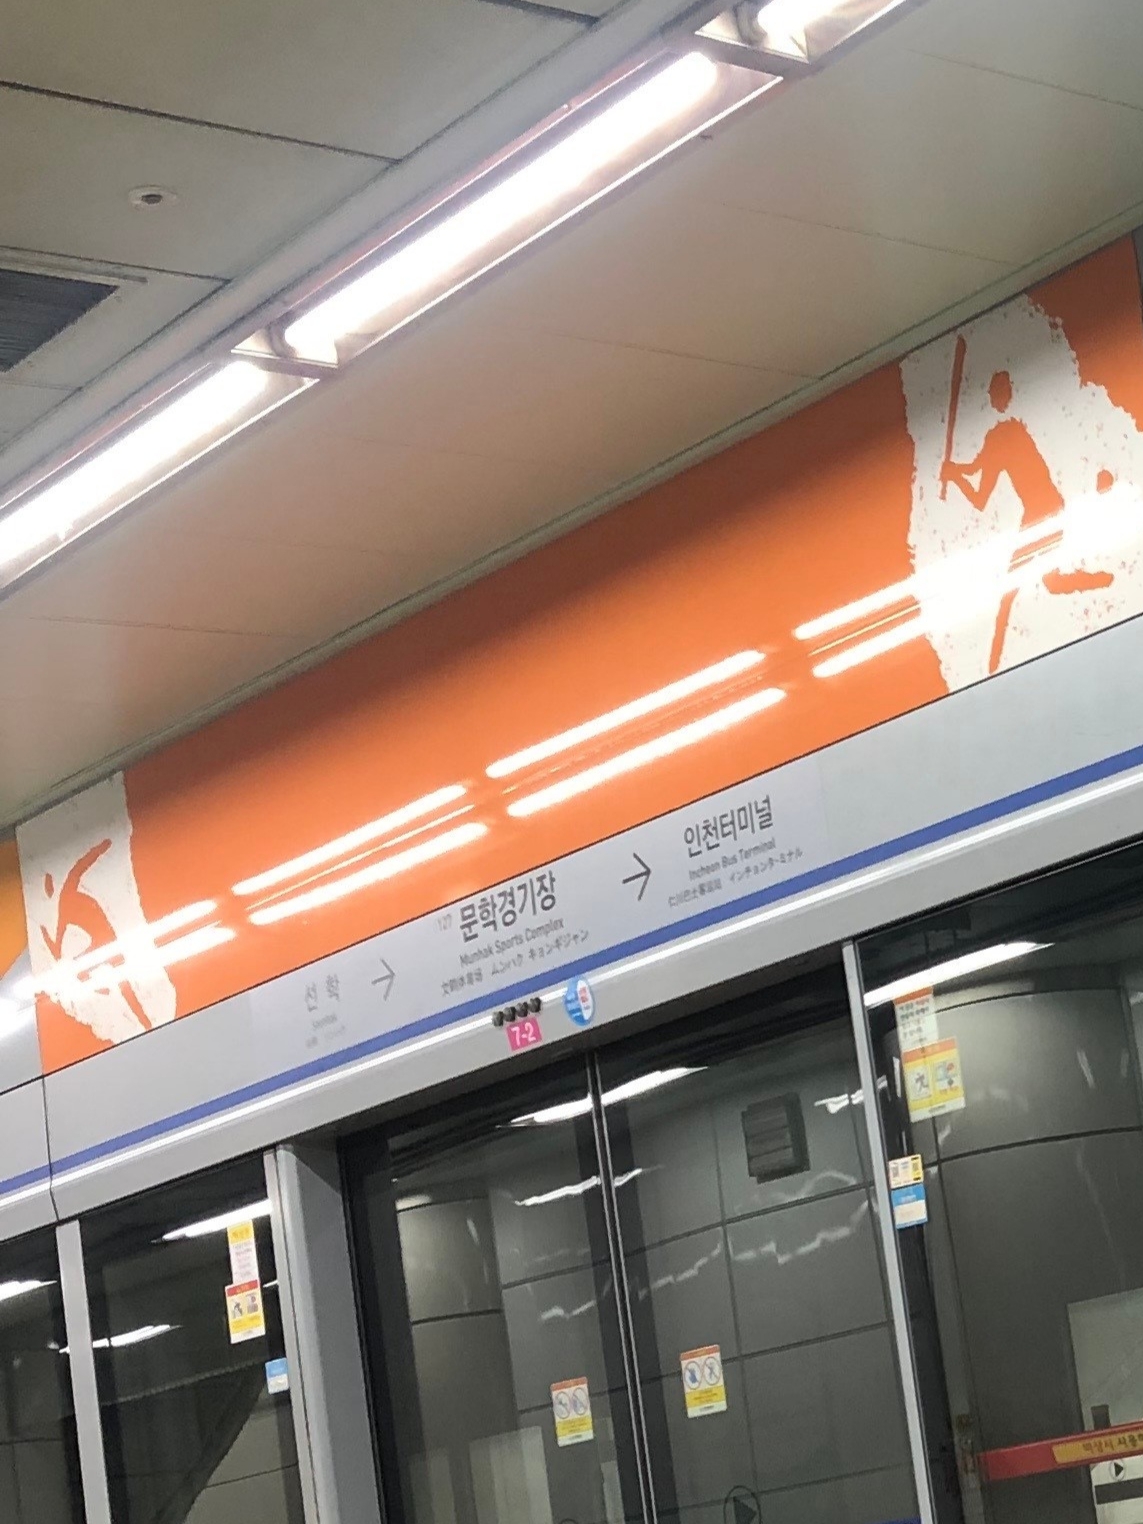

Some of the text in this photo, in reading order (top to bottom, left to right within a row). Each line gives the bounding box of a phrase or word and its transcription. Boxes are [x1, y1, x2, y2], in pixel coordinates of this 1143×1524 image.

[683, 794, 773, 858] 인천터미널
[721, 854, 738, 869] Bus
[738, 837, 776, 860] Terminal
[459, 869, 556, 943] 문학경기장
[459, 918, 565, 967] Munhak Sports Complex
[513, 1023, 537, 1044] 7-2
